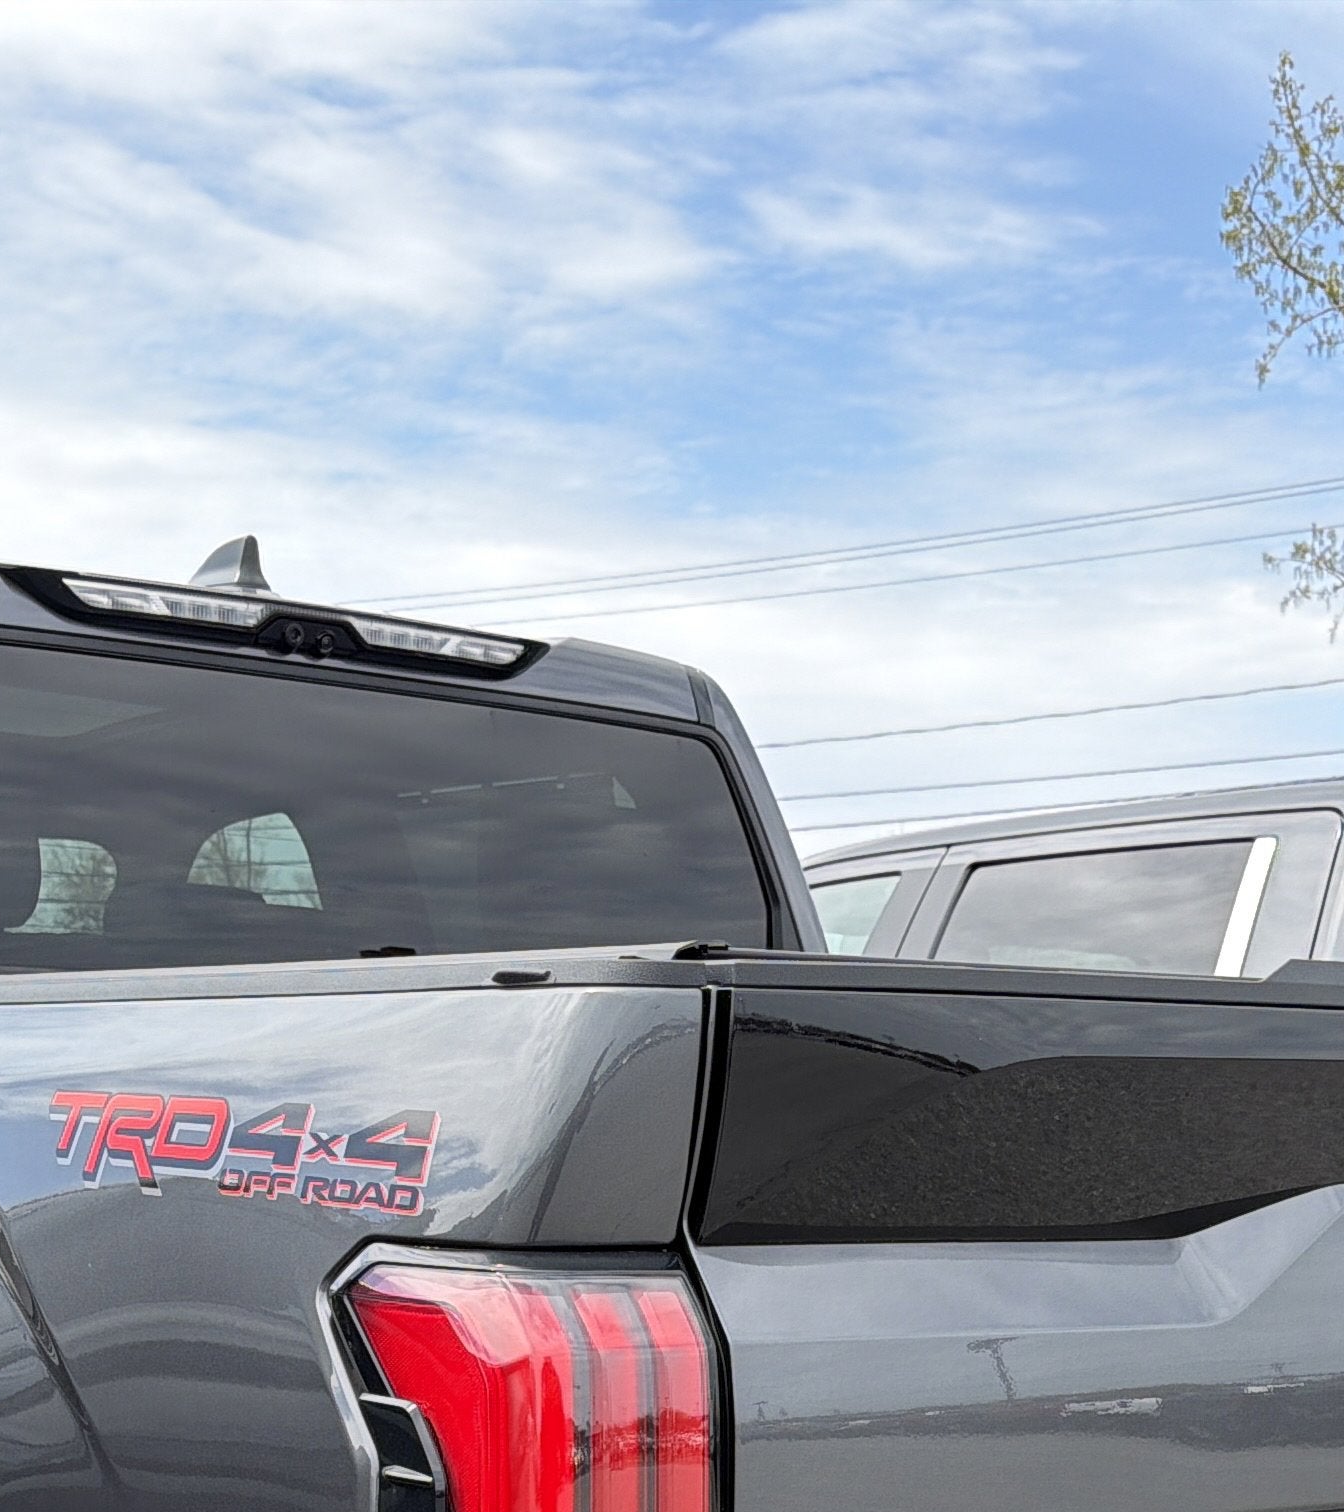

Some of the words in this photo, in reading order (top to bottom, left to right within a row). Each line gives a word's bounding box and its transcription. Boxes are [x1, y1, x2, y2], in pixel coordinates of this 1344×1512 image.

[50, 1089, 233, 1196] TRD
[228, 1103, 440, 1184] 4x4
[218, 1169, 296, 1201] OFF
[299, 1175, 424, 1216] ROAD
